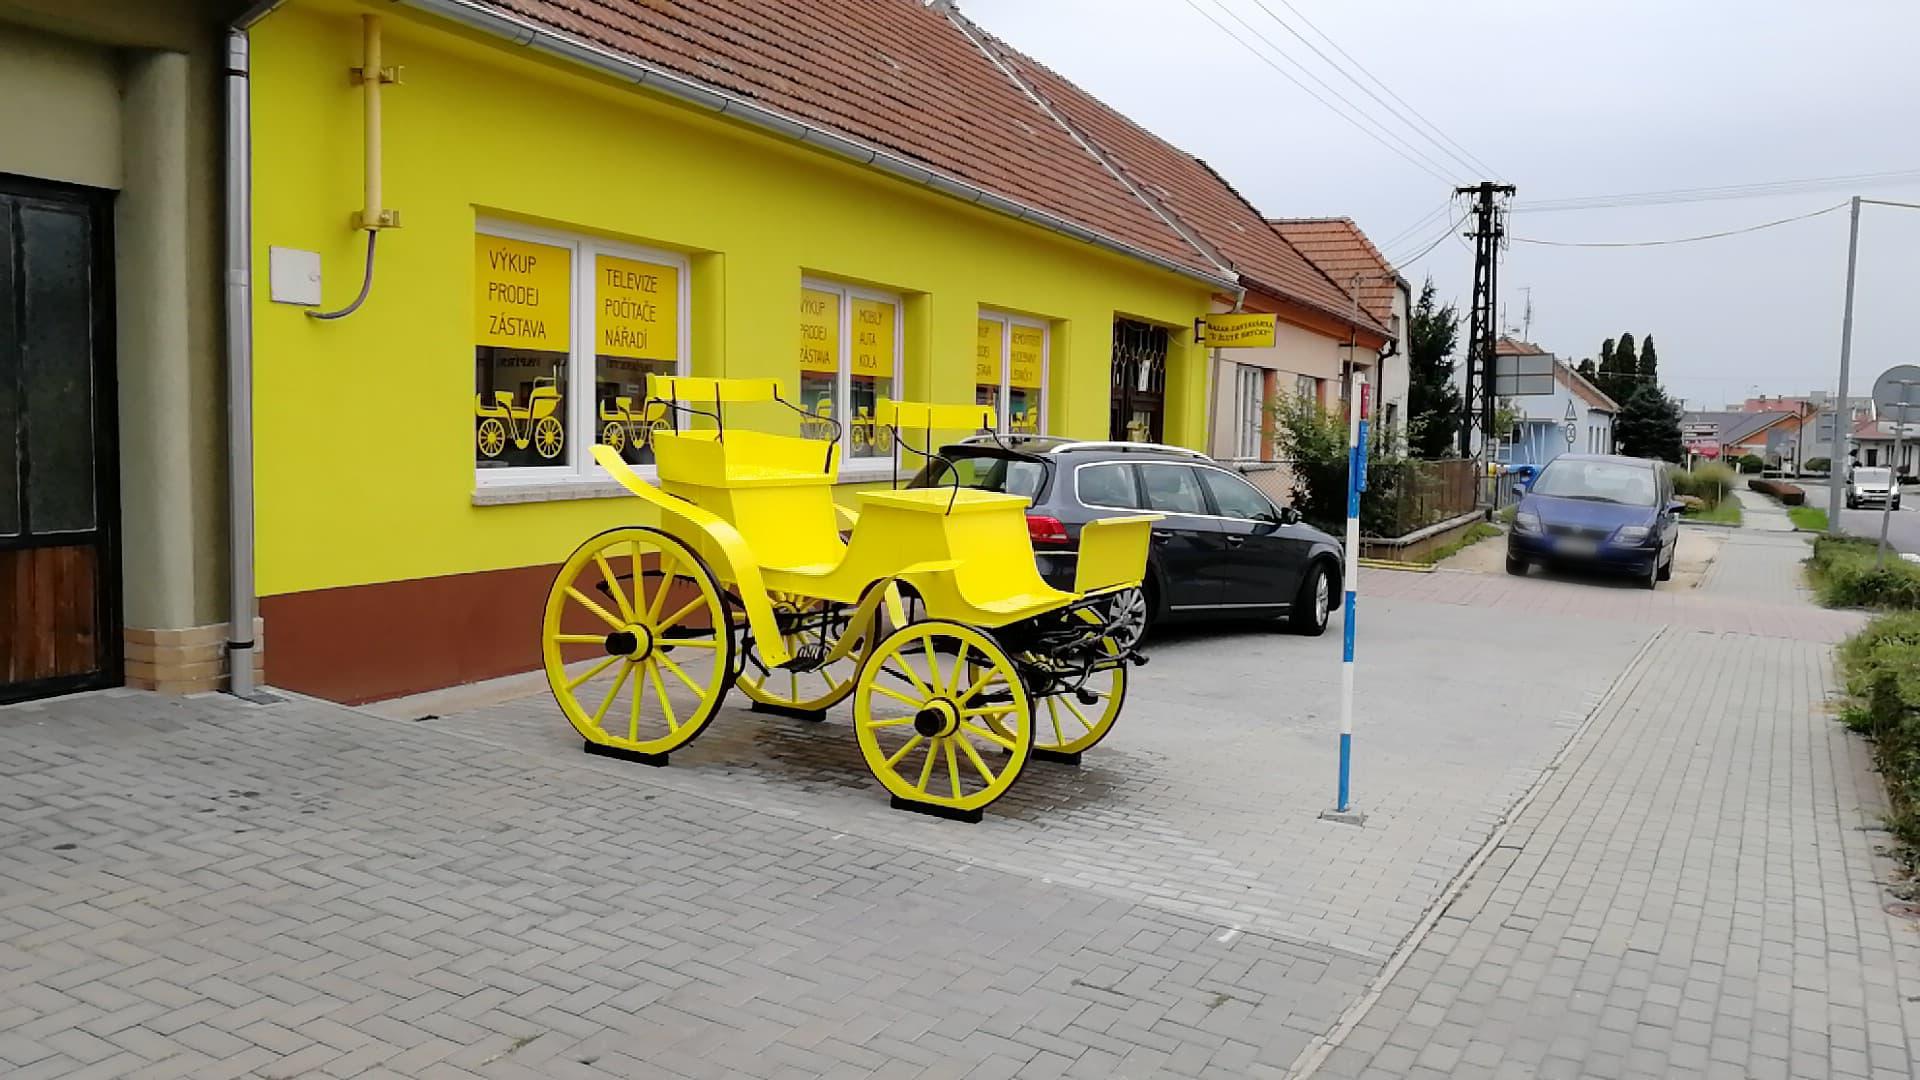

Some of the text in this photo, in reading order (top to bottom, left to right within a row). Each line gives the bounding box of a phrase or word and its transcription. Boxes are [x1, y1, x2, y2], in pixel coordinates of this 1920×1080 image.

[489, 248, 537, 274] VÝKUP
[606, 268, 658, 293] TELEVIZE
[489, 282, 539, 306] PRODEJ
[605, 298, 657, 323] POČÍTAČE
[489, 312, 546, 339] ZÁSTAVA
[605, 326, 648, 350] NÁŘADÍ
[859, 332, 877, 346] AUTA
[859, 354, 878, 369] KOLA
